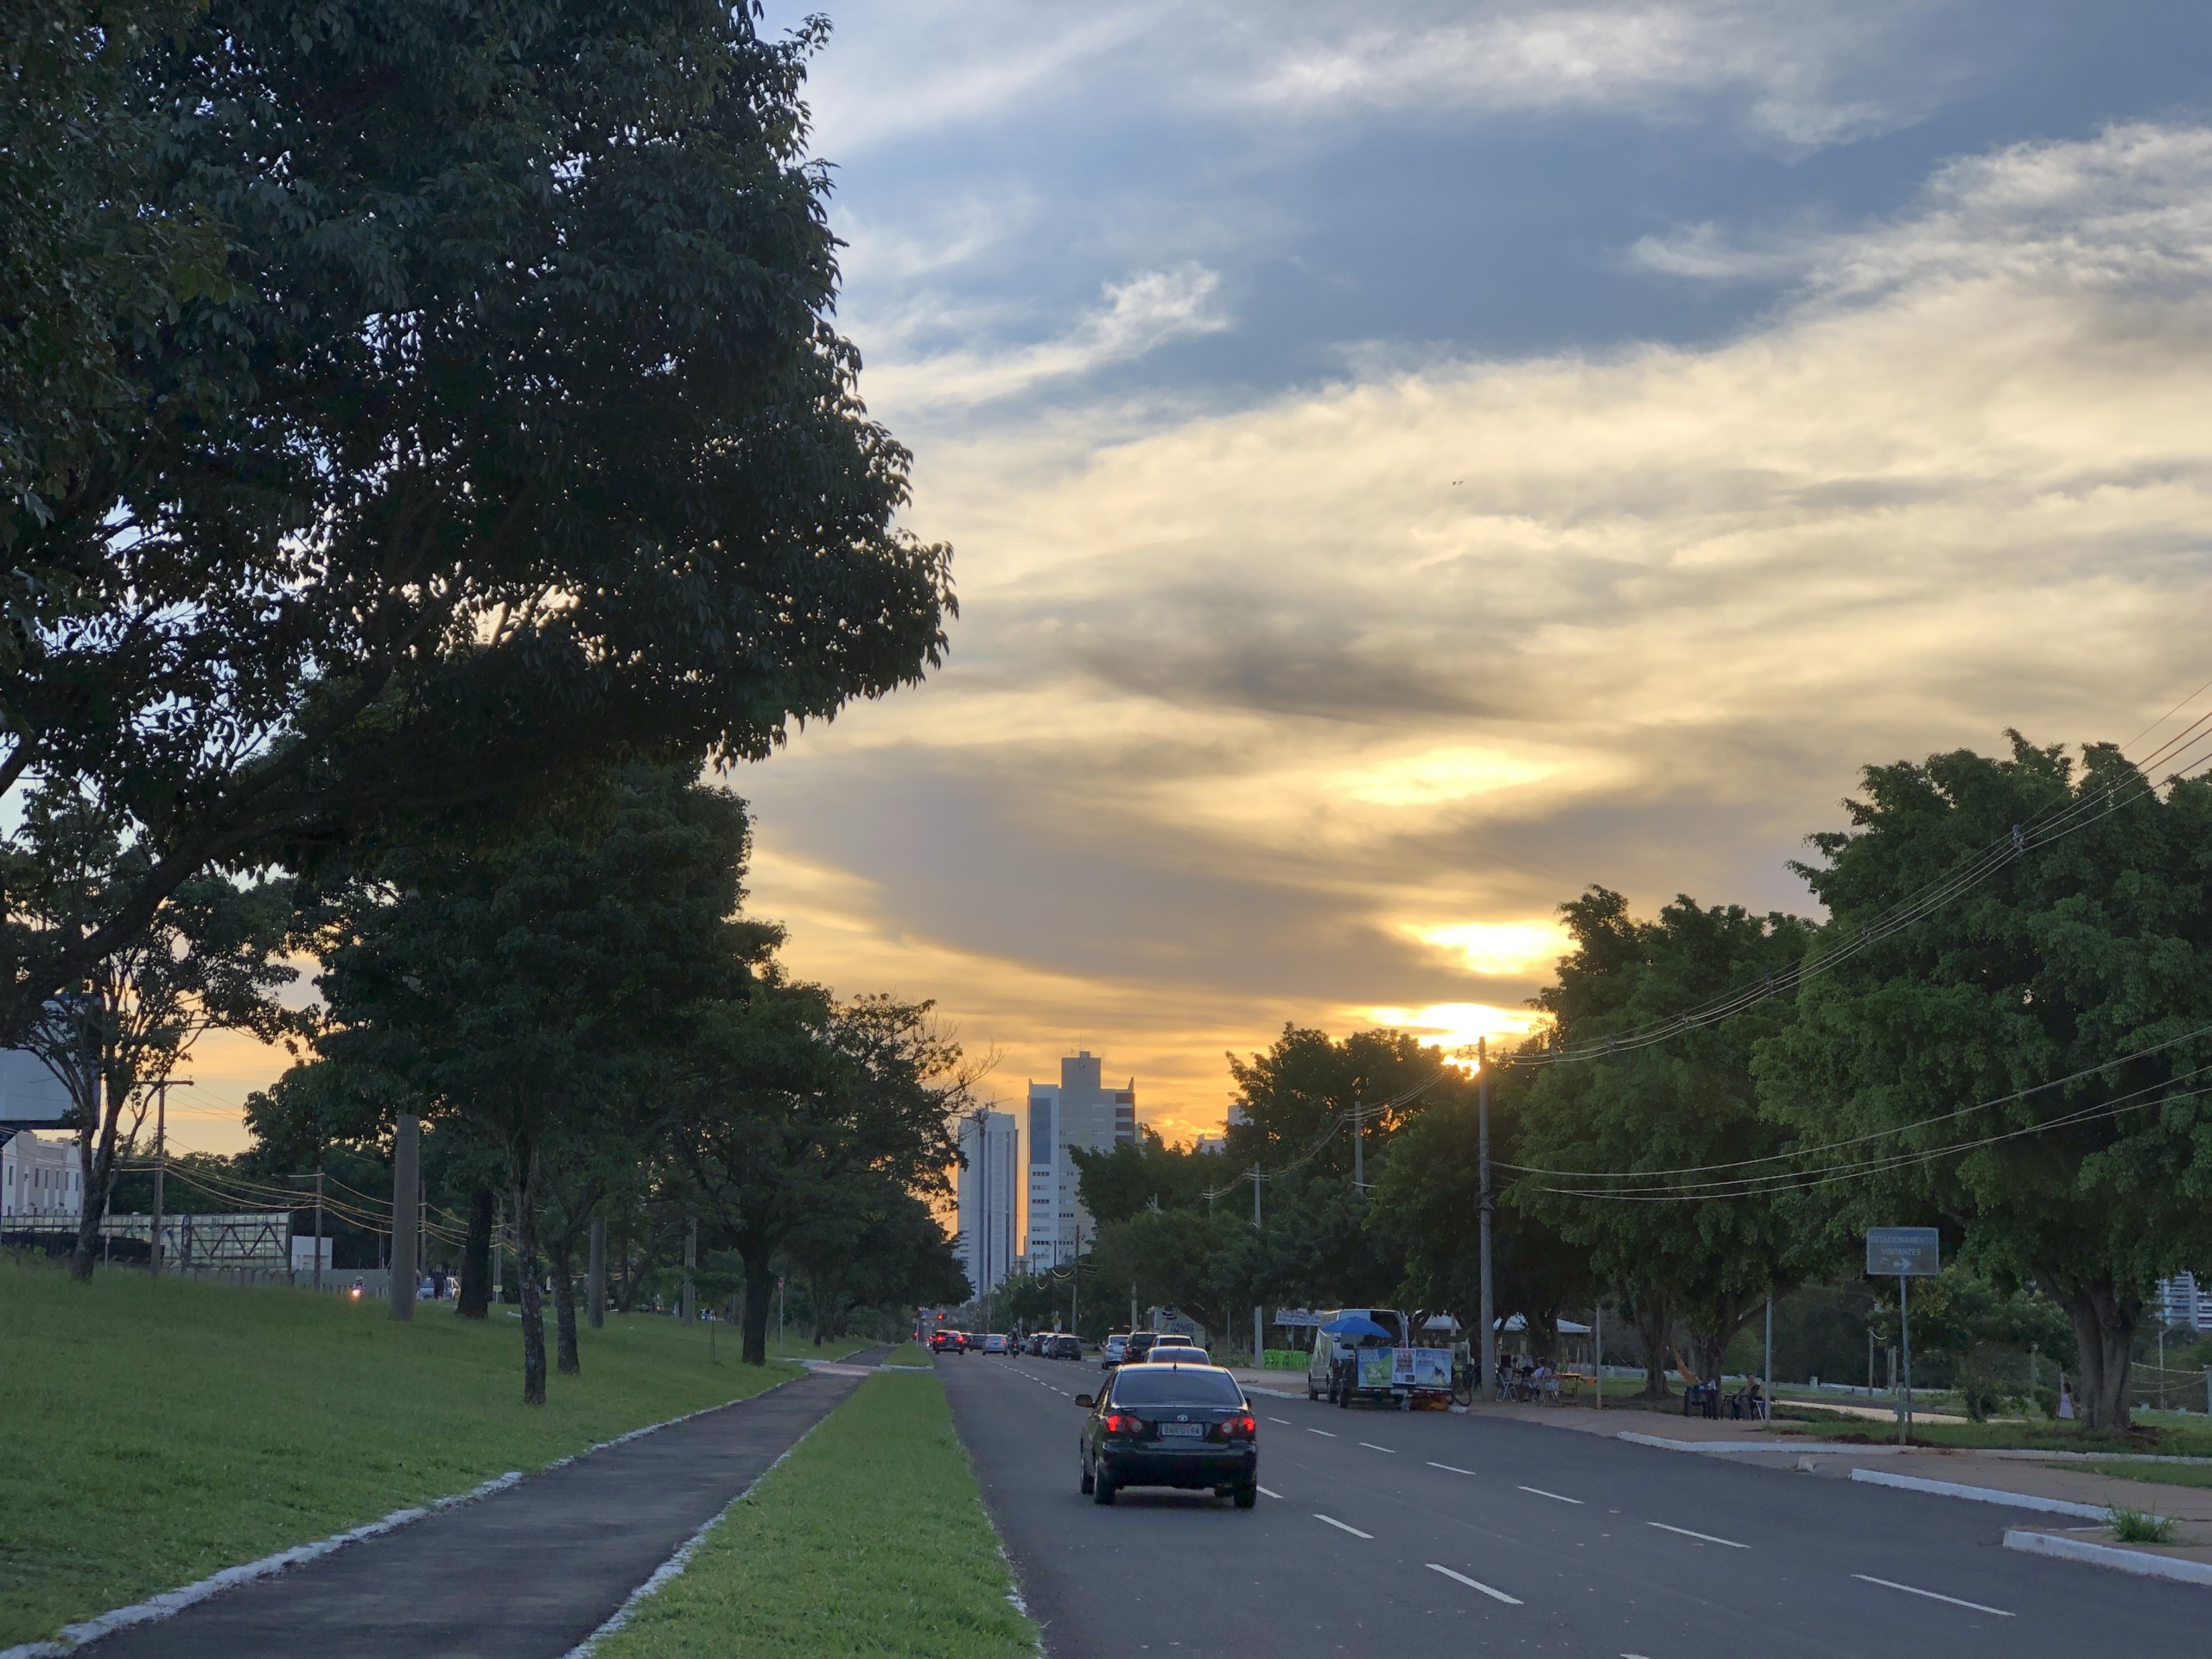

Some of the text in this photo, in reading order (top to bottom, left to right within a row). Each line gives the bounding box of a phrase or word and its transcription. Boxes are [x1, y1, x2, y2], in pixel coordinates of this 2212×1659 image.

[1869, 1236, 1935, 1245] ESTACIONAMENTO
[1881, 1248, 1922, 1256] VISITANTES
[1359, 1353, 1379, 1363] COCO
